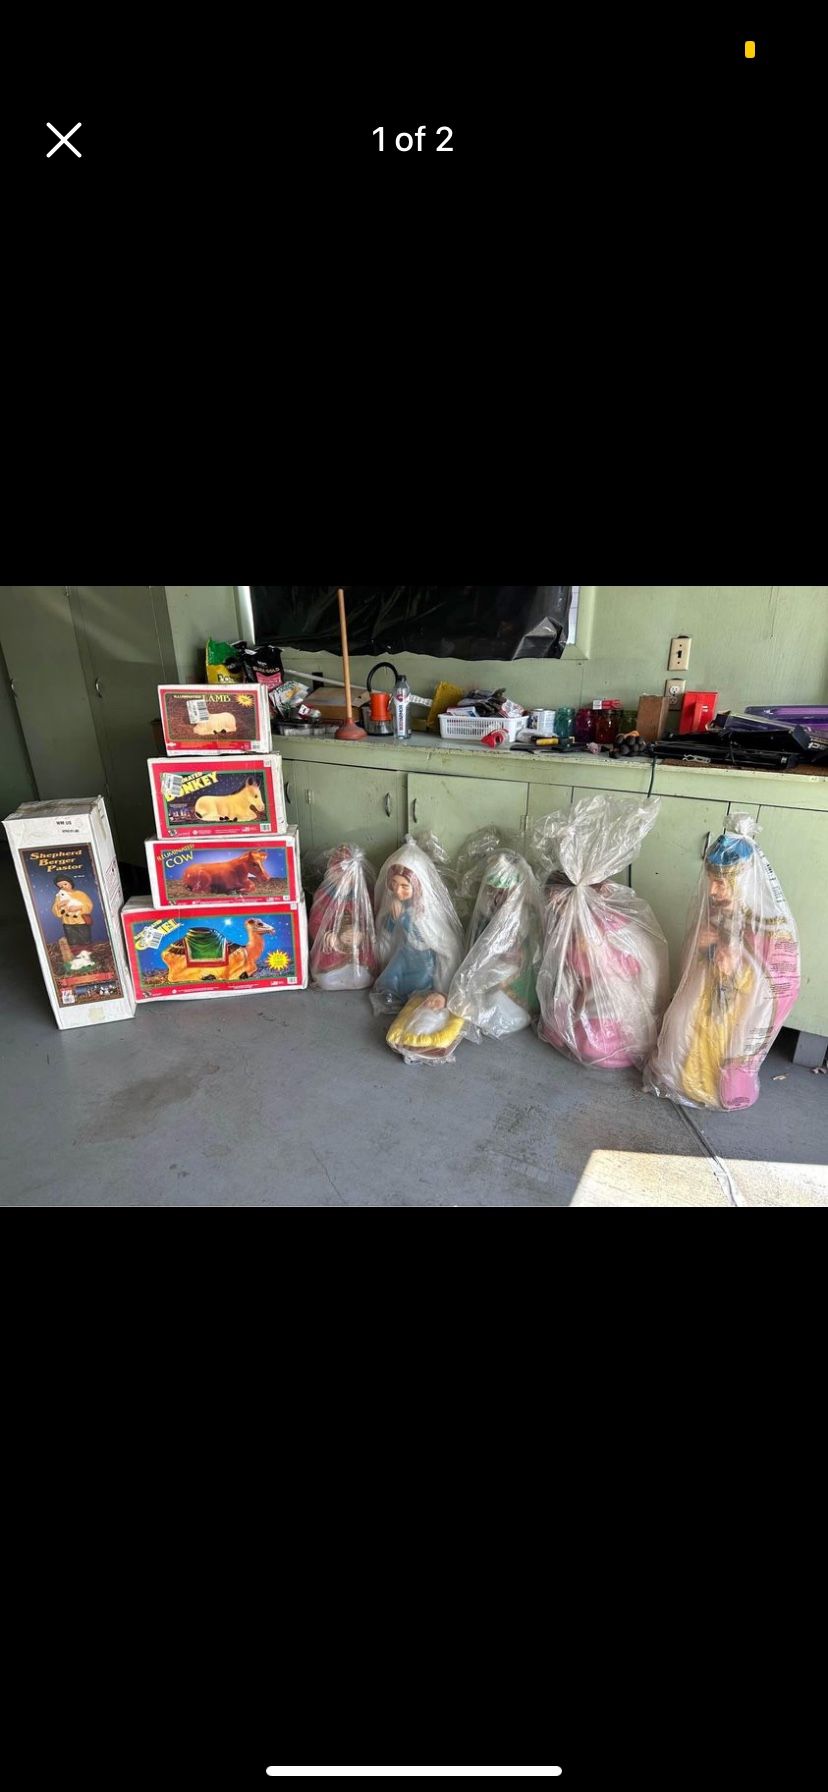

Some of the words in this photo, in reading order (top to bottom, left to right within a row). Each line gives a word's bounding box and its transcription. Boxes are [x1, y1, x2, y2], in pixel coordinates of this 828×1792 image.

[203, 694, 231, 702] LAMB
[164, 771, 218, 802] NKEY
[30, 850, 82, 860] Shepherd
[166, 850, 193, 868] COW
[39, 858, 77, 867] Berger
[47, 864, 84, 873] Pastor
